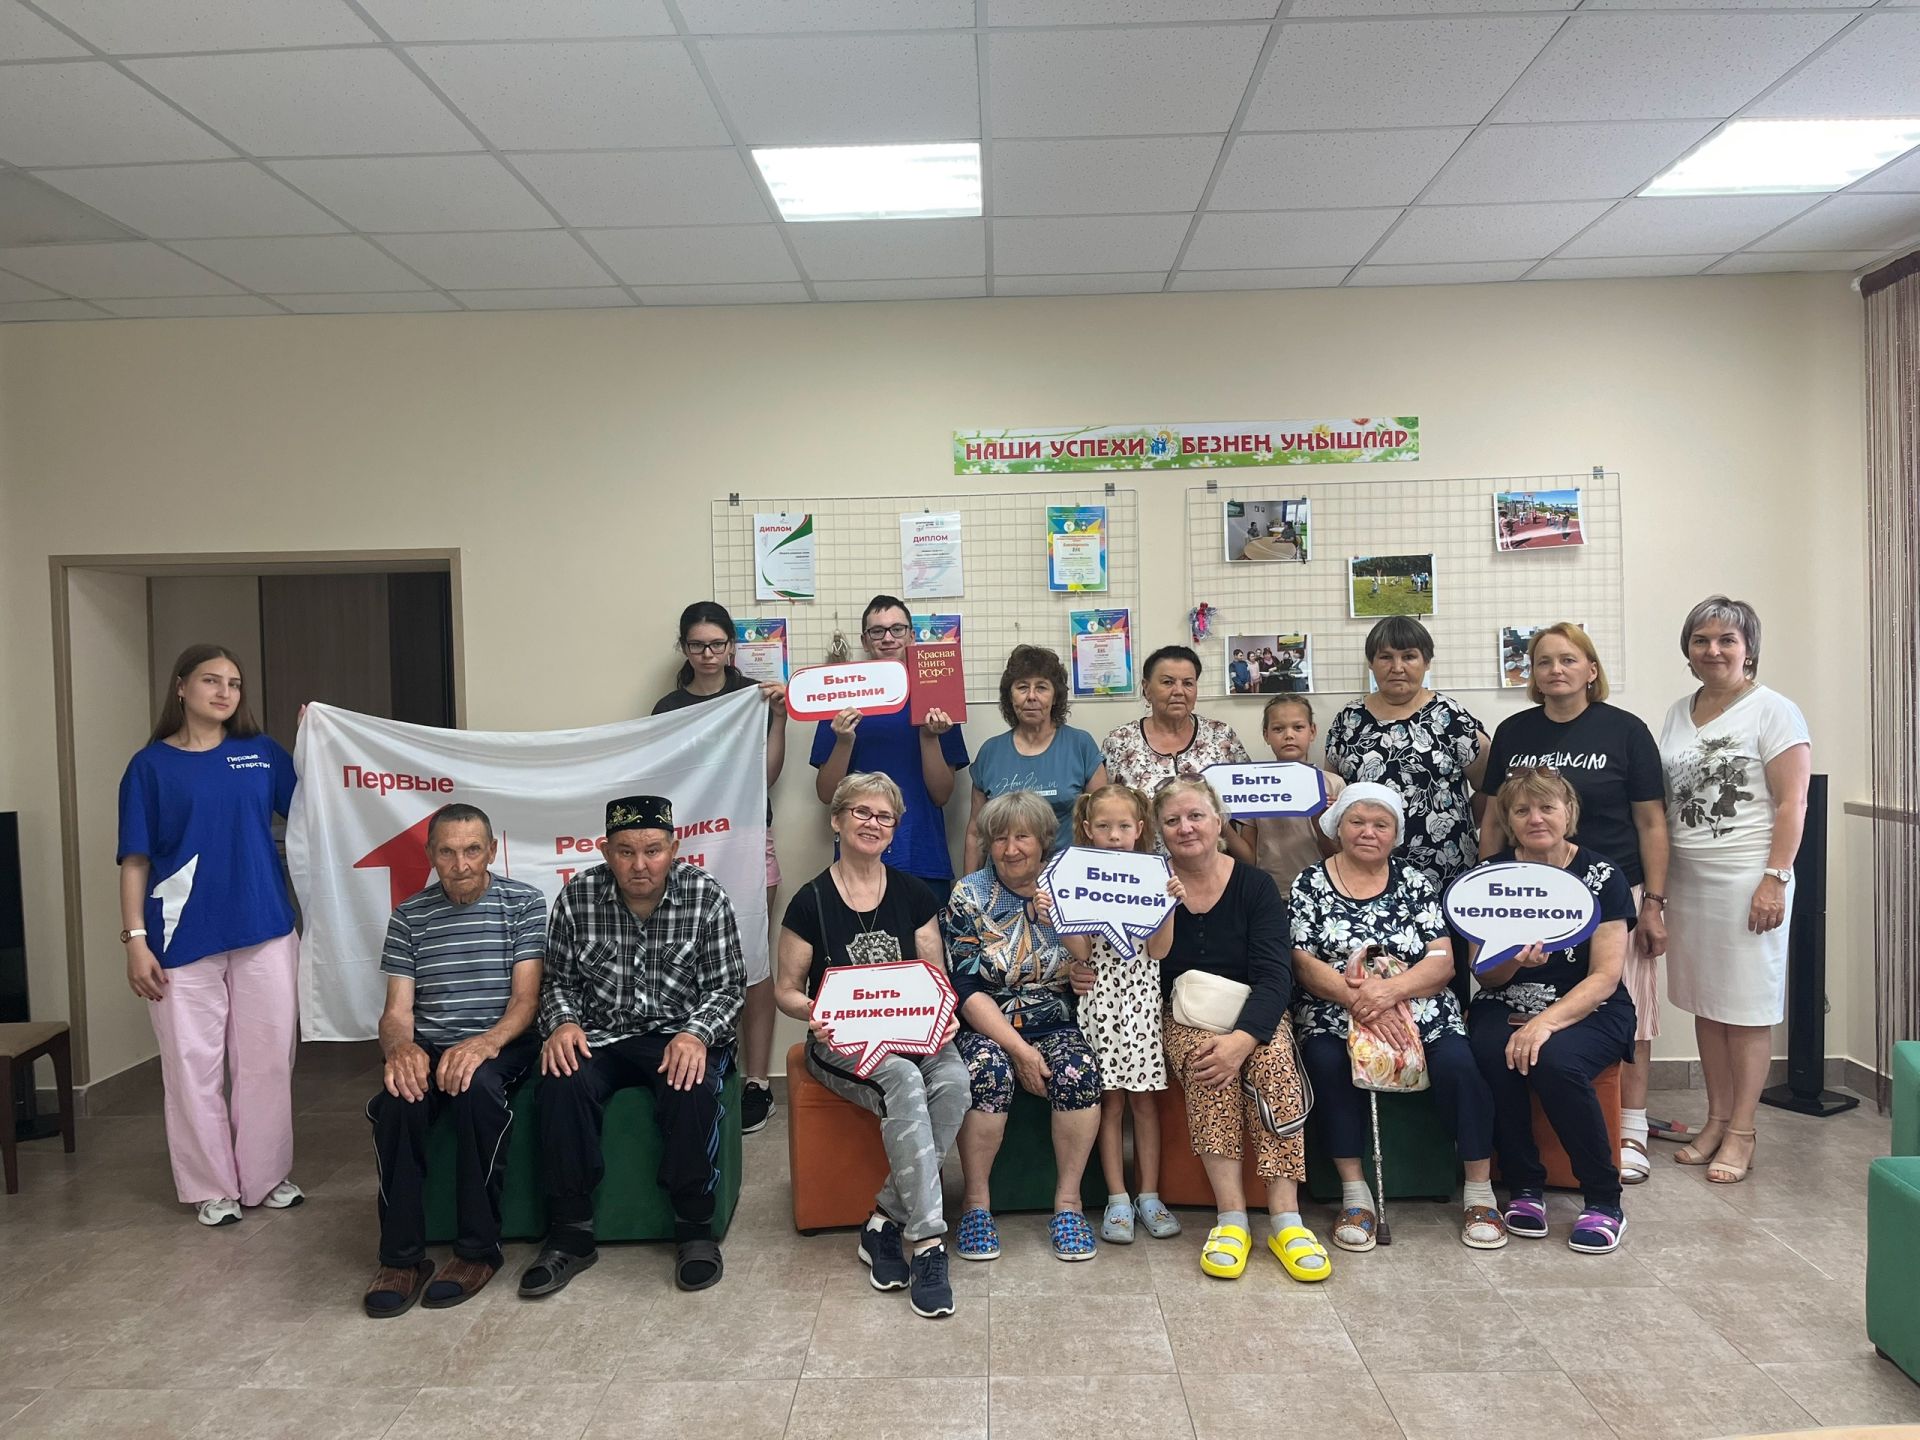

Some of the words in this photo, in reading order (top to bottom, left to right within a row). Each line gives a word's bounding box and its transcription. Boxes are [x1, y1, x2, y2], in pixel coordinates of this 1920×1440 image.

[966, 441, 1041, 460] НАШИ
[1050, 438, 1144, 457] УСПЕХИ
[913, 535, 949, 544] ДИПЛОМ
[917, 650, 955, 660] Красная
[918, 660, 946, 668] книга
[919, 668, 954, 678] РСФСР
[823, 675, 867, 685] Быть
[806, 687, 885, 702] первыми
[343, 765, 454, 796] Первые
[1231, 774, 1282, 785] Быть
[1222, 793, 1292, 803] вместе
[1086, 866, 1141, 884] Быть
[1488, 882, 1548, 898] Быть
[1057, 888, 1070, 899] с
[1074, 886, 1166, 908] Россией
[1453, 906, 1583, 920] человеком
[852, 988, 901, 1001] Быть
[821, 1010, 831, 1019] в
[834, 1006, 935, 1021] движении
